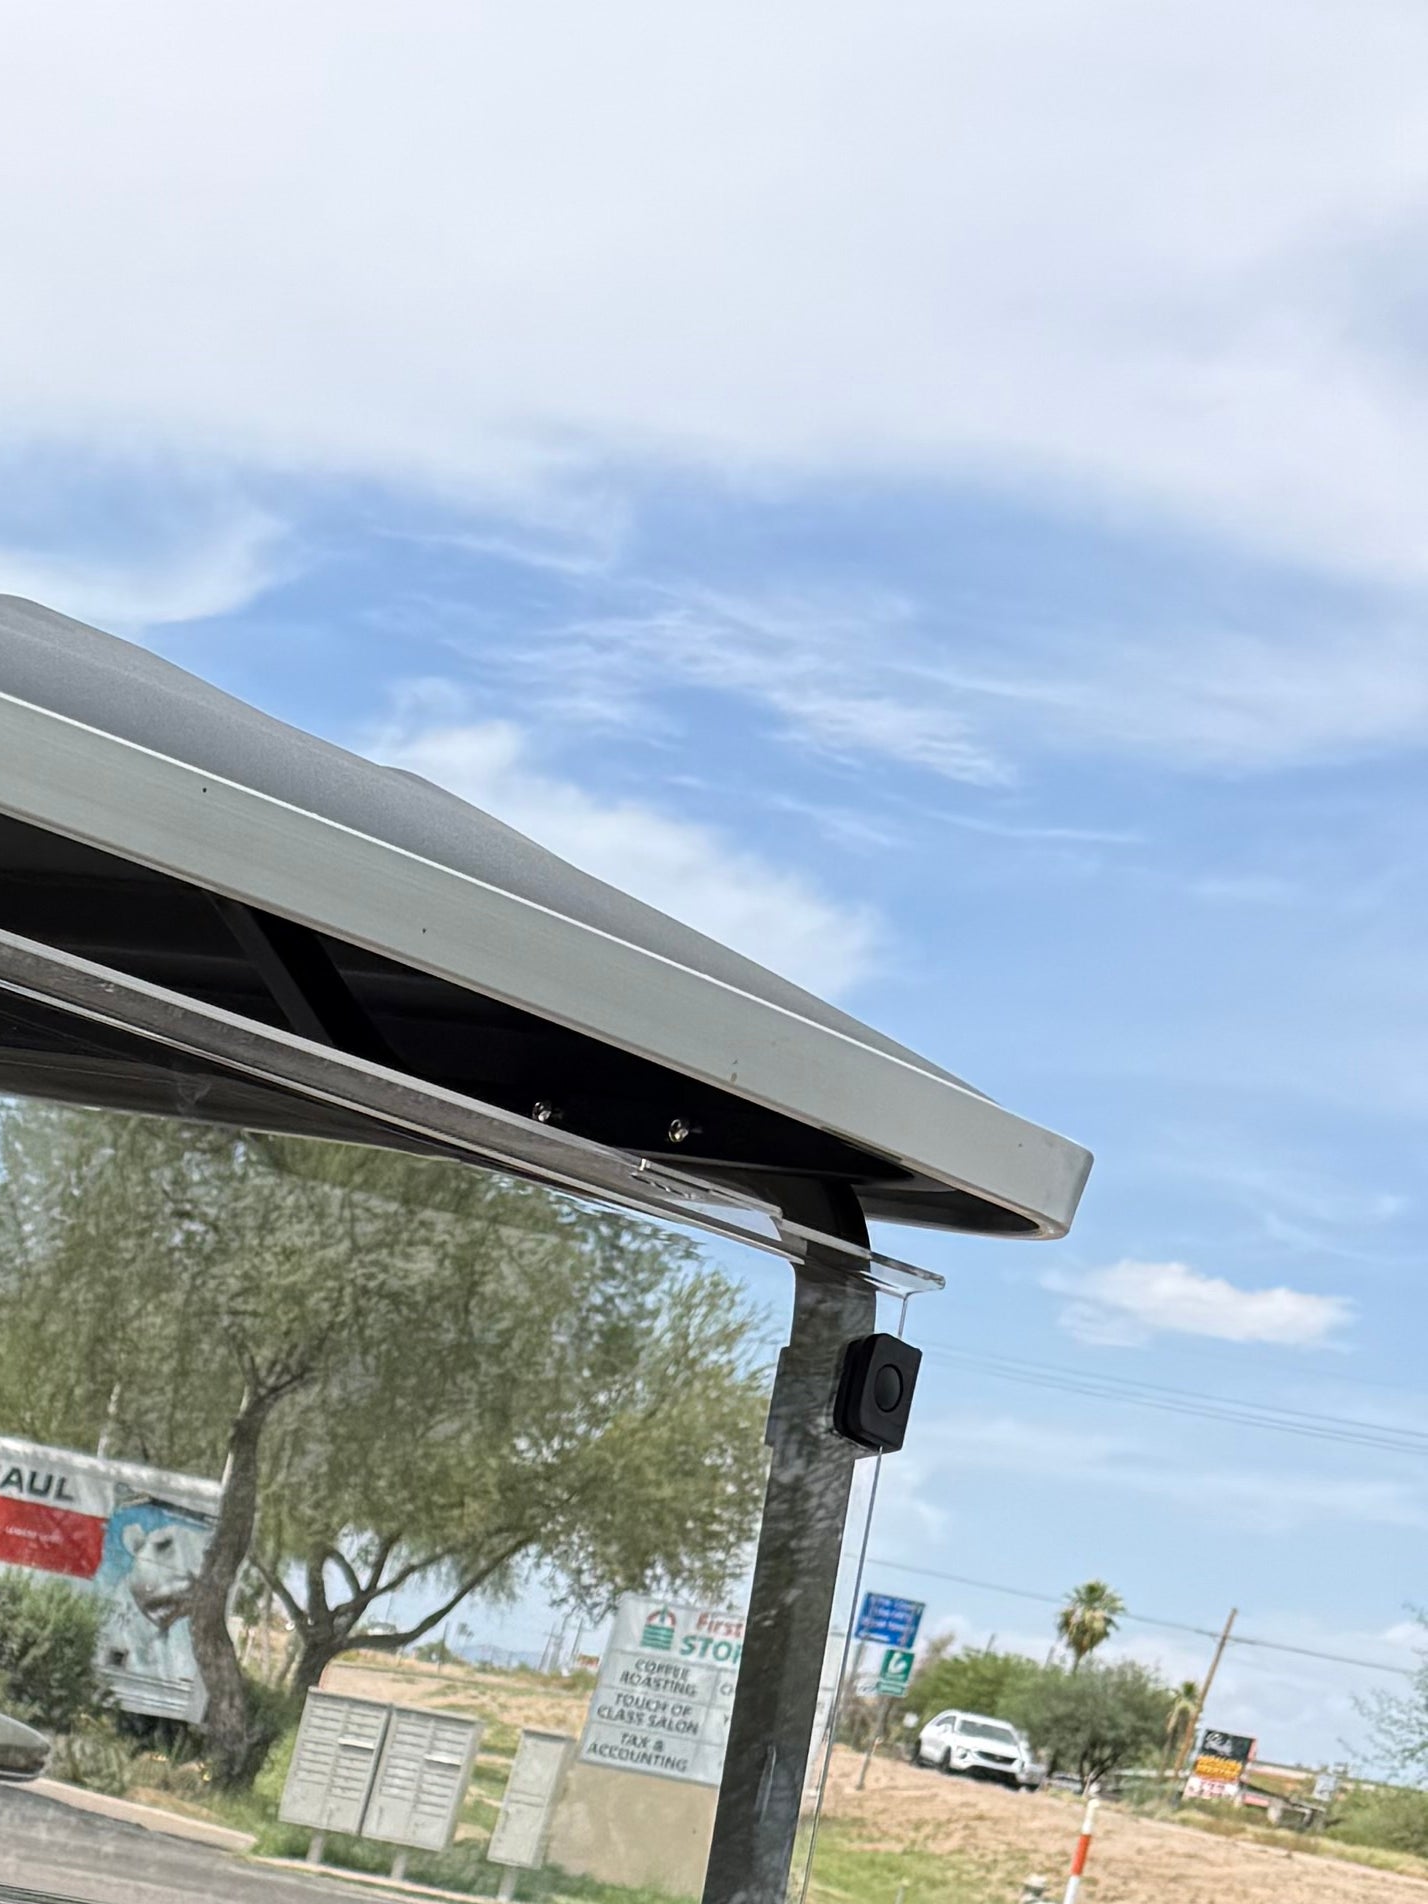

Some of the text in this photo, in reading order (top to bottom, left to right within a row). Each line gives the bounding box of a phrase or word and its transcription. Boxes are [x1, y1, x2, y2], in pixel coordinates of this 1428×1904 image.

[696, 1611, 745, 1638] First
[635, 1658, 691, 1682] COFFEE
[620, 1671, 698, 1697] ROASTING
[616, 1693, 693, 1717] TOUCH OF
[597, 1706, 645, 1726] CLASS
[648, 1714, 699, 1735] SALON
[621, 1732, 648, 1748] TAX
[587, 1743, 689, 1773] ACCOUNTING
